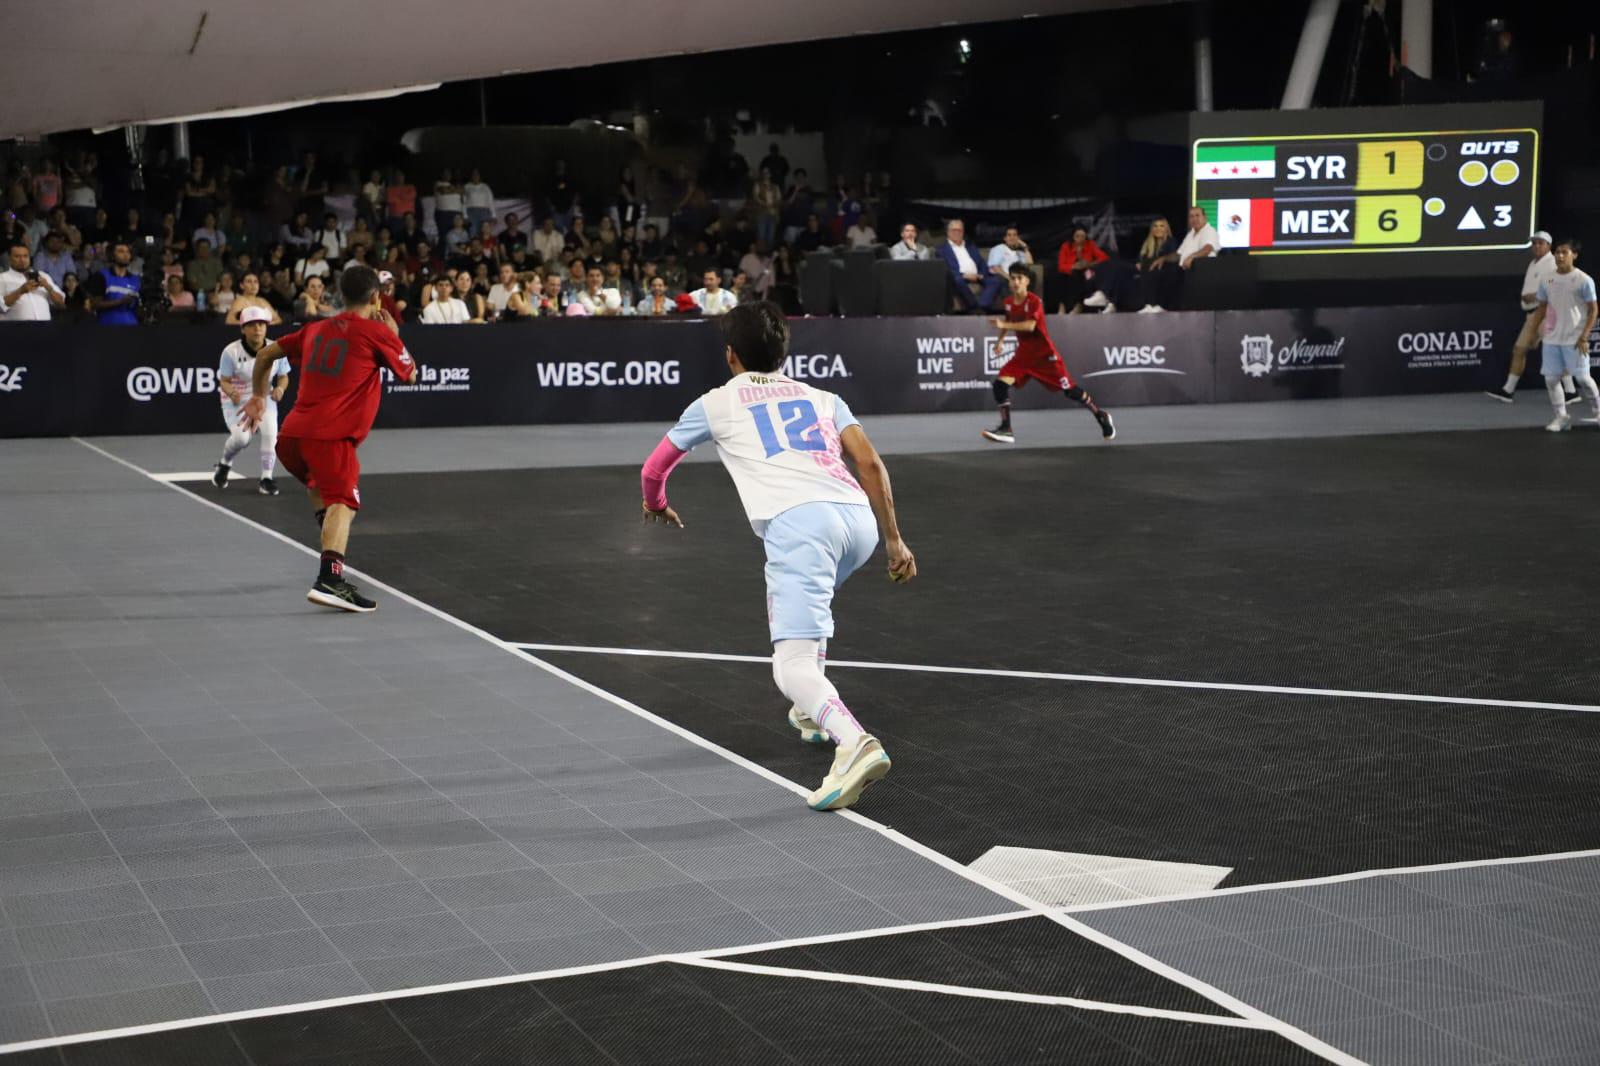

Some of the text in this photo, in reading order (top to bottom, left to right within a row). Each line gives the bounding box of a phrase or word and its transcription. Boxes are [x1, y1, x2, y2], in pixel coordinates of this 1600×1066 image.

[1460, 141, 1520, 156] OUTS
[1286, 151, 1397, 181] SYR 1
[1281, 209, 1399, 234] MEX 6
[1494, 204, 1512, 227] 3
[916, 337, 974, 354] WATCH
[1278, 336, 1345, 365] Nayarit
[1398, 330, 1493, 353] CONADE
[304, 335, 349, 376] 10
[781, 354, 848, 378] MEGA
[917, 358, 953, 374] LIVE
[1103, 345, 1166, 365] WBSC
[126, 366, 220, 401] @WB
[421, 364, 437, 381] la
[440, 367, 470, 384] paz
[536, 360, 681, 387] WBSC.ORG
[419, 383, 430, 391] las
[431, 382, 470, 391] adicciones
[738, 385, 808, 404] OCHOA
[747, 399, 827, 458] 12
